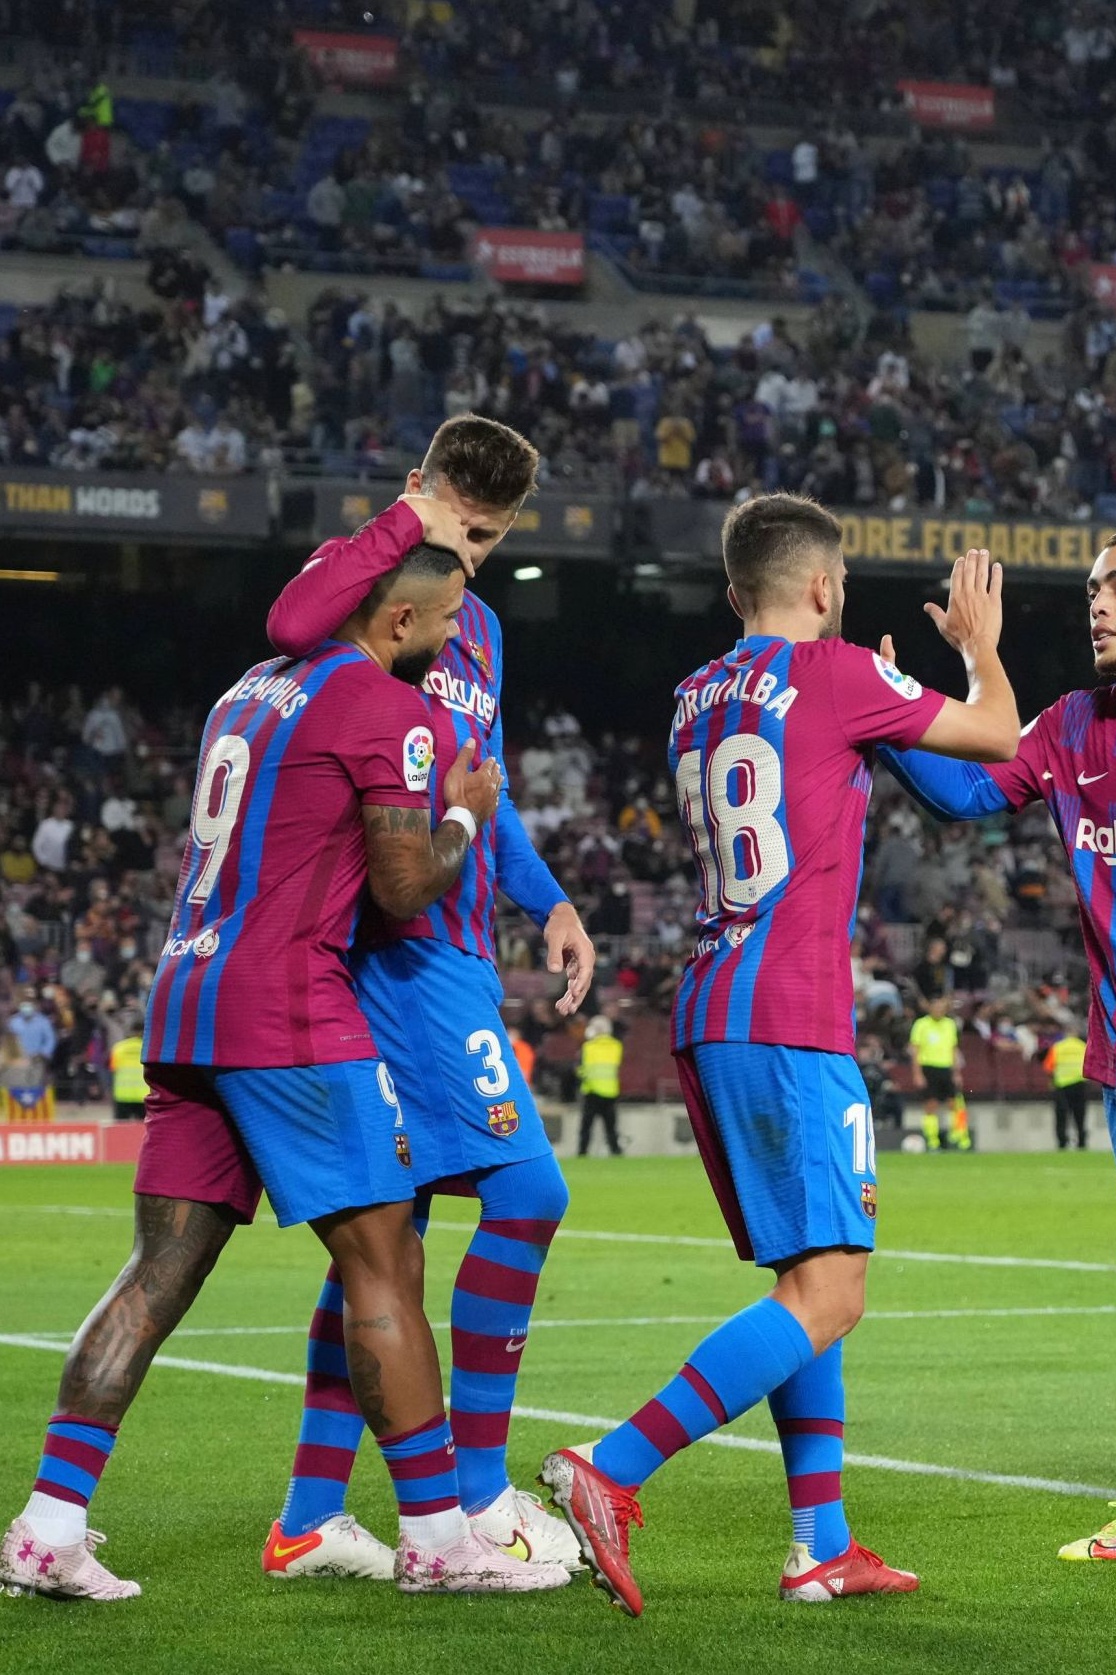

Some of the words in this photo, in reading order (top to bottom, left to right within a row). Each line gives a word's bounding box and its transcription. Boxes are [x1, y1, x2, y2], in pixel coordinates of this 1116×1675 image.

[6, 483, 71, 513] THAN
[76, 486, 160, 518] WORDS
[214, 675, 308, 719] MEMPHIS
[723, 669, 799, 720] ALBA
[187, 735, 250, 904] 9
[676, 733, 790, 916] 18
[466, 1029, 510, 1098] 3
[8, 1131, 95, 1161] DAMM
